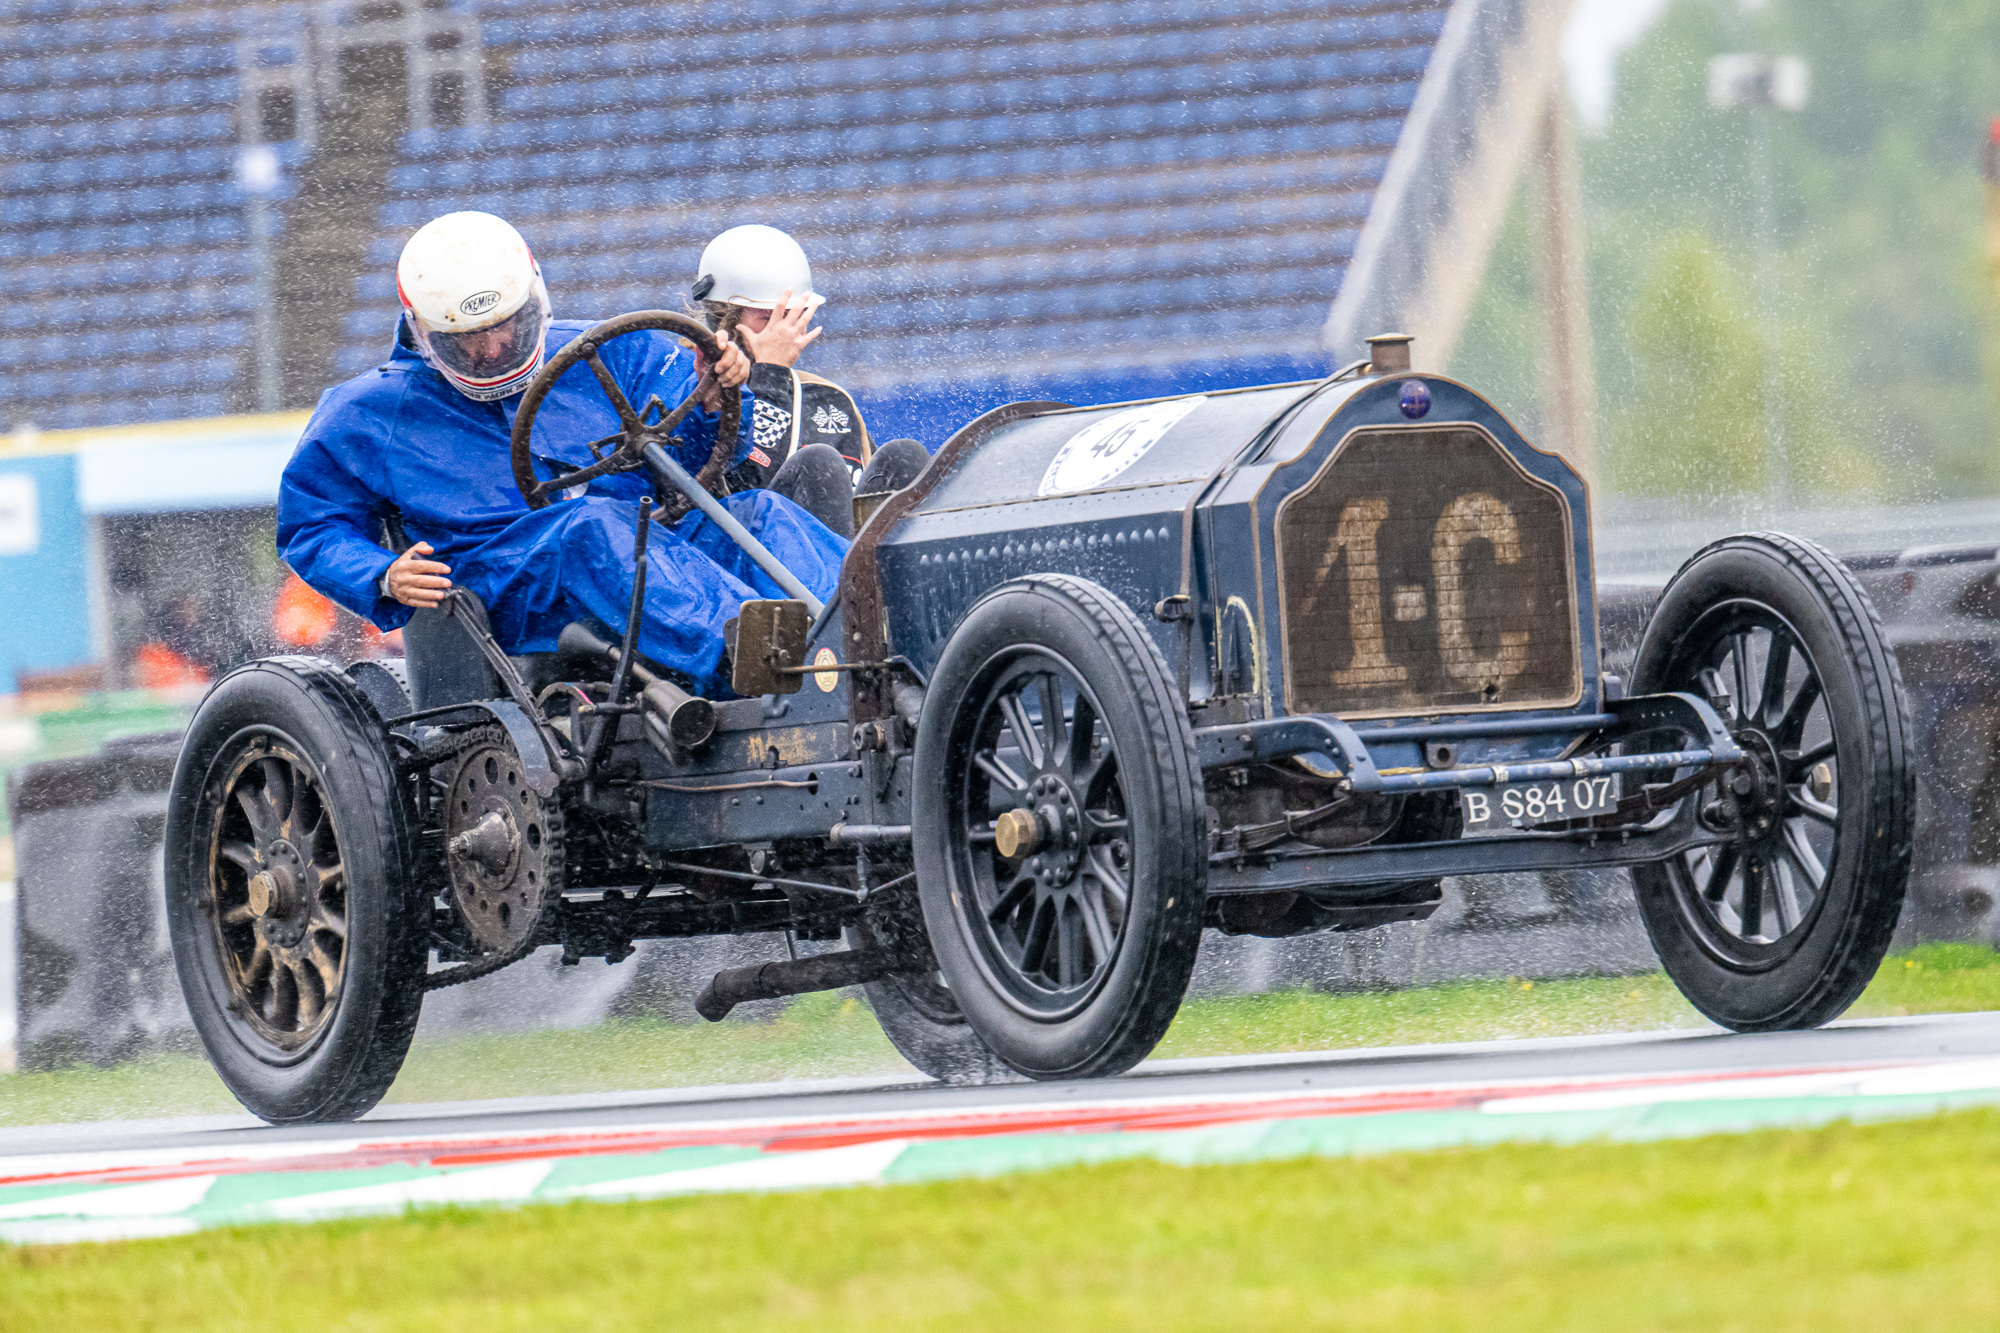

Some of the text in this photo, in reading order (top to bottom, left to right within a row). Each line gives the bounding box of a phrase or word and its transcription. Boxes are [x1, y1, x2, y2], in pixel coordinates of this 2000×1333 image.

[463, 293, 498, 313] PREMIER
[484, 387, 514, 400] PACIFIC
[1090, 419, 1151, 458] 45
[1464, 792, 1491, 824] B
